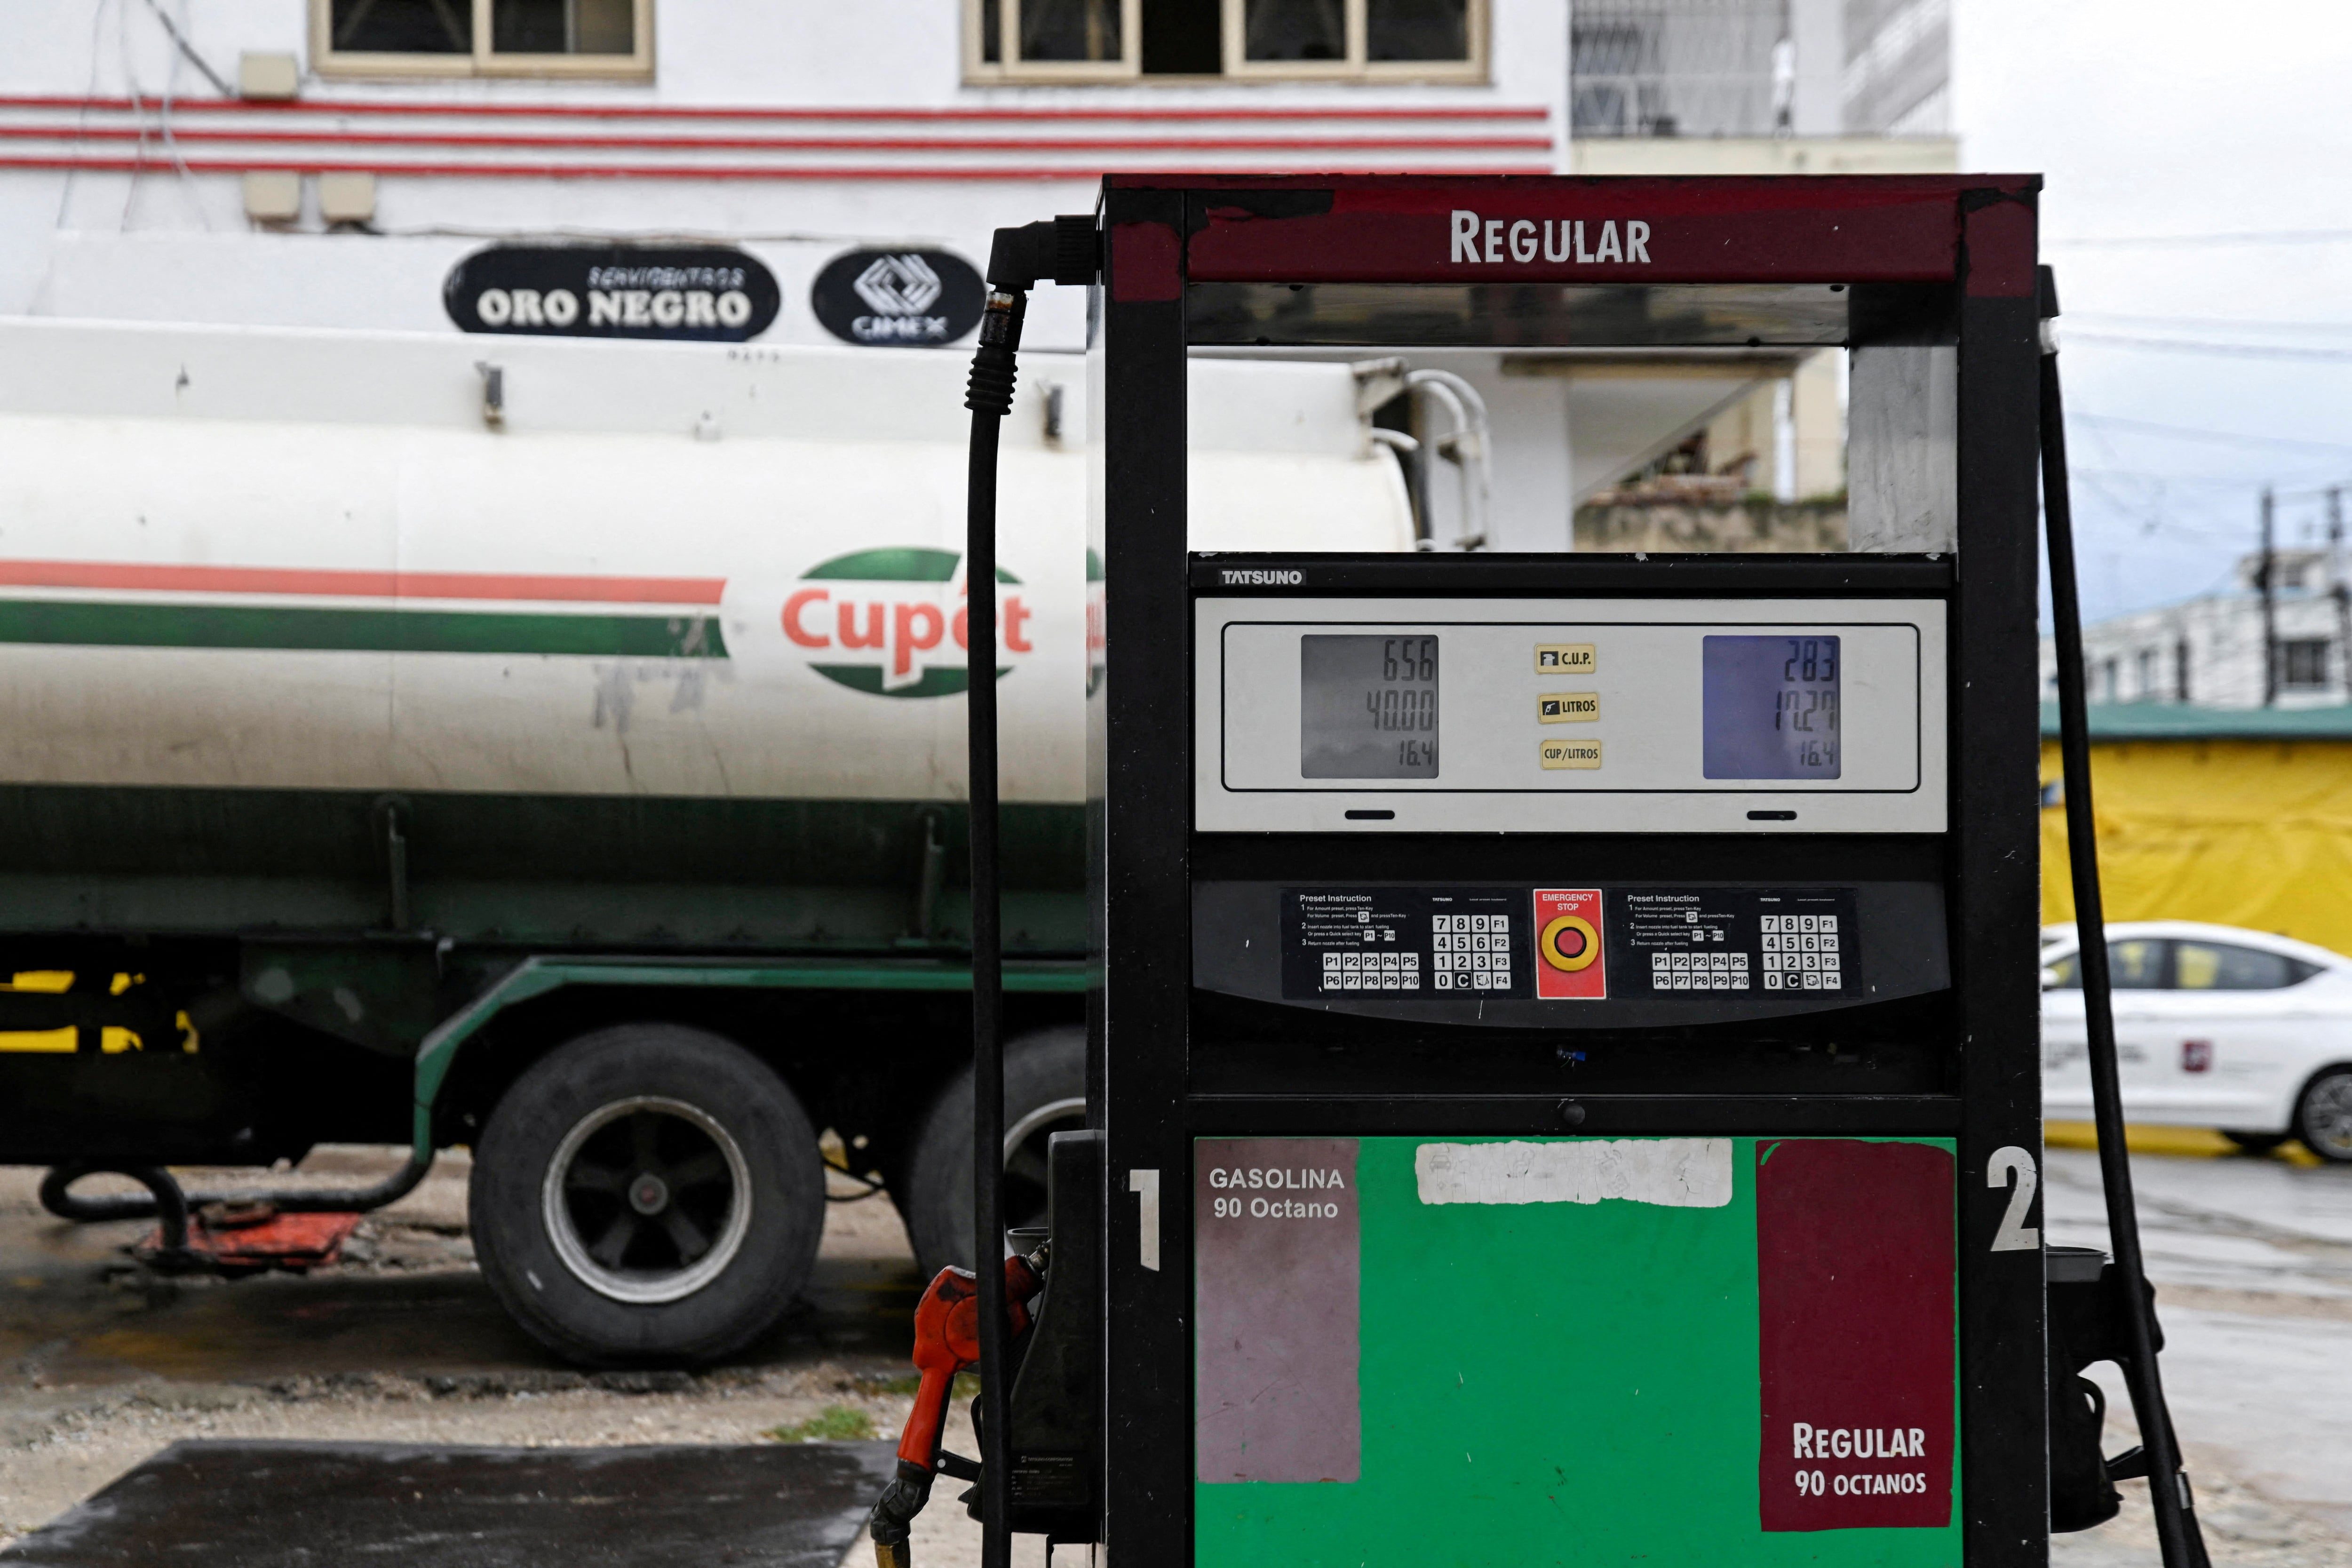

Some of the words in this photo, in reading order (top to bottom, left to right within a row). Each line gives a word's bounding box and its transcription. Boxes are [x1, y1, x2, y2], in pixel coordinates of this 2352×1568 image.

[1451, 209, 1651, 263] REGULAR
[477, 288, 579, 326] ORO
[587, 290, 752, 326] NEGRO
[852, 316, 948, 339] CIMEX
[1222, 570, 1302, 584] TATSUNO
[1383, 640, 1433, 681] 656
[1562, 653, 1591, 665] C.U.P.
[1785, 640, 1836, 681] 283
[1367, 690, 1434, 731] 40.00
[1563, 700, 1596, 712] LITROS
[1776, 691, 1836, 731] 17.27
[1399, 740, 1432, 766] 16.4
[1801, 740, 1835, 766] 16.4
[1437, 918, 1446, 930] 7
[1456, 918, 1465, 930] 8
[1476, 918, 1485, 930] 9
[1765, 918, 1774, 930] 7
[1785, 918, 1794, 930] 8
[1804, 918, 1813, 930] 9
[1438, 937, 1447, 949] 4
[1457, 937, 1466, 949] 5
[1477, 937, 1486, 949] 6
[1767, 937, 1776, 949] 4
[1787, 937, 1795, 949] 5
[1805, 937, 1814, 949] 6
[1326, 957, 1338, 966] P1
[1345, 957, 1359, 966] P2
[1364, 957, 1378, 966] P3
[1383, 957, 1398, 966] P4
[1403, 956, 1417, 966] P5
[1439, 955, 1445, 968] 1
[1458, 955, 1467, 968] 2
[1478, 955, 1486, 968] 3
[1654, 957, 1667, 966] P1
[1674, 957, 1688, 966] P2
[1693, 957, 1707, 966] P3
[1713, 957, 1727, 966] P4
[1732, 957, 1746, 966] P5
[1768, 955, 1774, 968] 1
[1787, 956, 1796, 968] 2
[1807, 956, 1815, 968] 3
[1326, 976, 1340, 985] P6
[1345, 976, 1359, 985] P7
[1365, 976, 1379, 985] P8
[1384, 976, 1398, 985] P9
[1402, 976, 1418, 985] P10
[1439, 974, 1448, 987] 0
[1457, 974, 1469, 987] C
[1655, 976, 1669, 985] P6
[1675, 976, 1689, 985] P7
[1694, 976, 1708, 985] P8
[1714, 976, 1728, 985] P9
[1732, 976, 1748, 985] P10
[1769, 975, 1778, 987] 0
[1787, 974, 1799, 987] C
[1209, 1168, 1345, 1189] GASOLINA
[1986, 1146, 2039, 1251] 2
[1214, 1197, 1242, 1218] 90
[1250, 1197, 1338, 1218] Octano
[1129, 1169, 1160, 1271] 1
[1794, 1423, 1924, 1459] REGULAR
[1795, 1470, 1825, 1496] 90
[1834, 1472, 1926, 1495] OCTANOS
